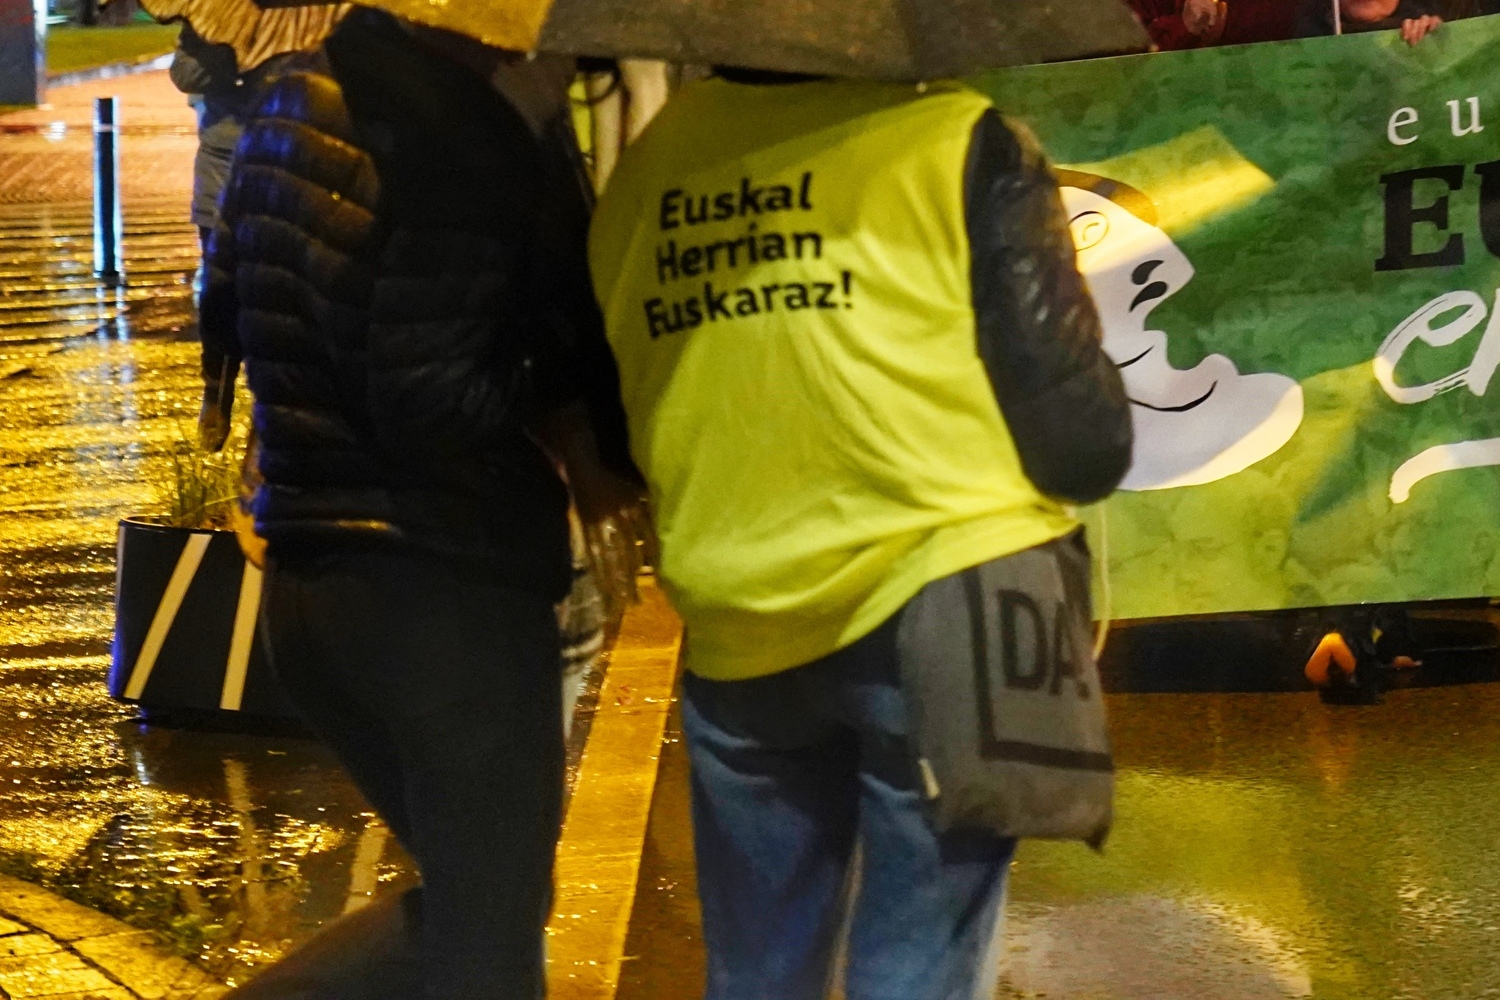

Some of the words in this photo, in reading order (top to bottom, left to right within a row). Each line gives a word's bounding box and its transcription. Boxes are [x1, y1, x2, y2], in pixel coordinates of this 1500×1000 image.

[659, 171, 813, 231] Euskal
[655, 222, 823, 285] Herrian
[643, 270, 854, 340] Euskaraz!
